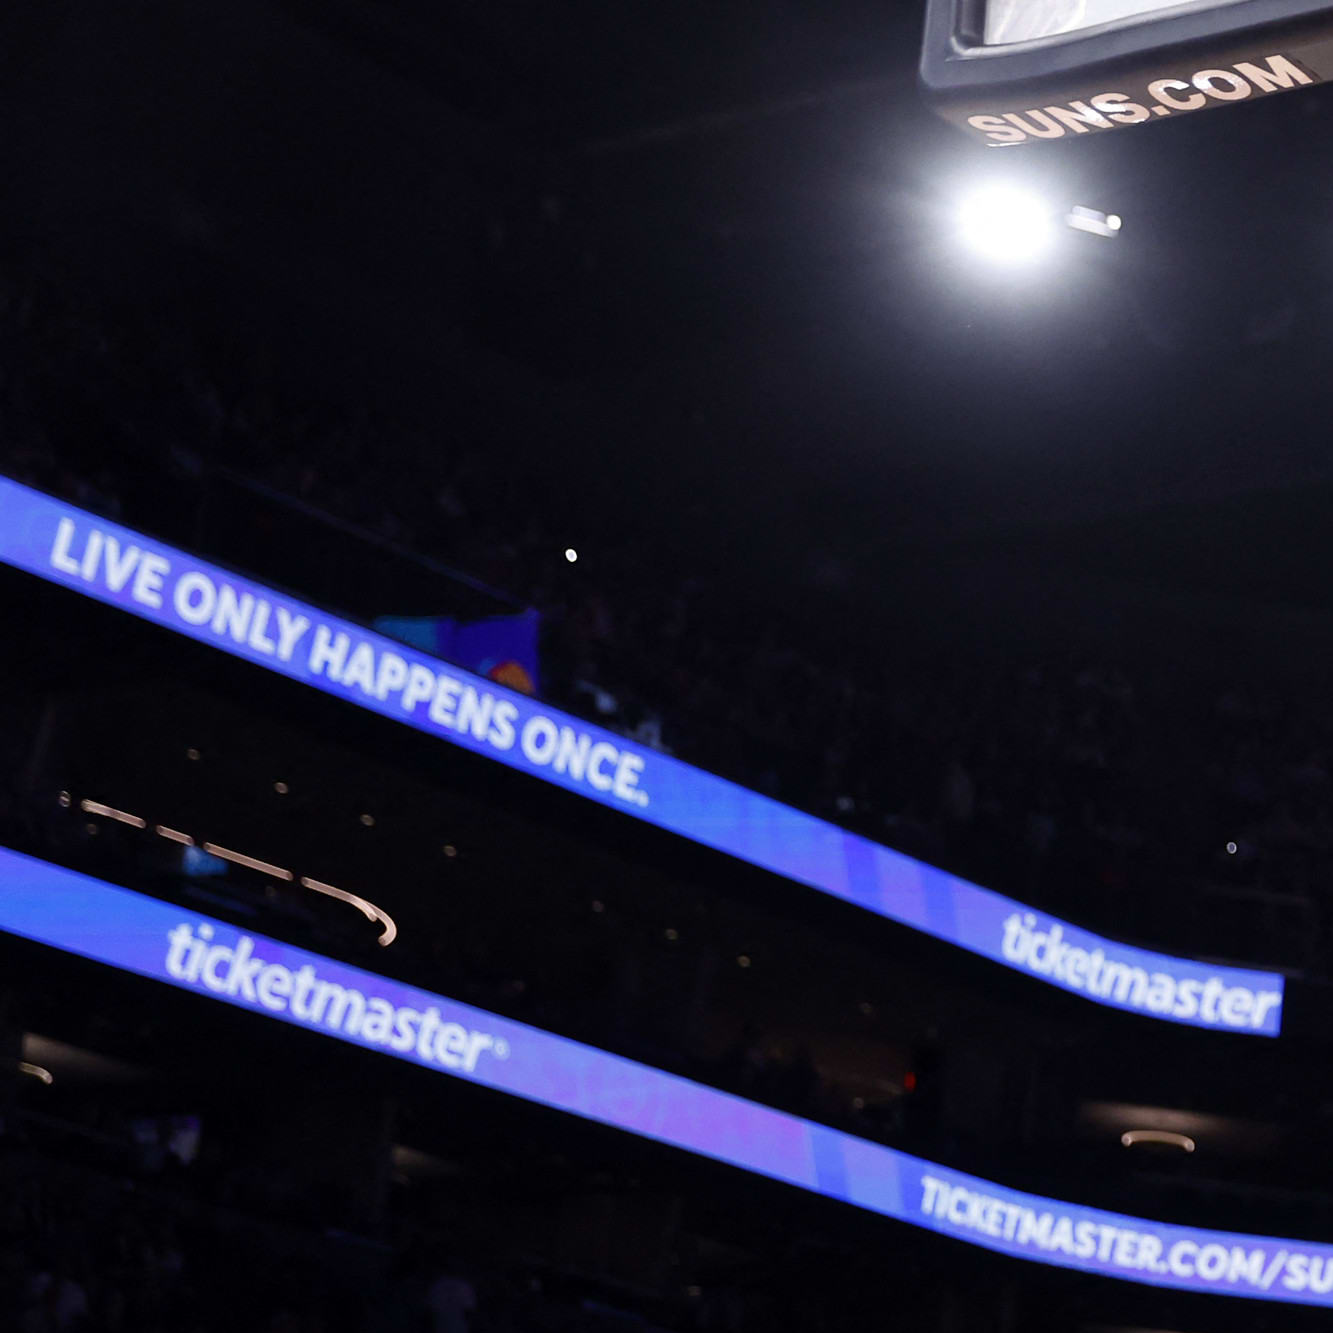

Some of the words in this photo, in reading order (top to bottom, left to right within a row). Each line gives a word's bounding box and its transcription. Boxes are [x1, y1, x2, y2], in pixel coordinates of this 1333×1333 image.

[968, 55, 1313, 143] SUNS.COM
[51, 516, 171, 610] LIVE
[173, 571, 311, 662] ONLY
[308, 625, 519, 750] HAPPENS
[521, 715, 649, 807] ONCE.
[1002, 912, 1282, 1028] ticketmaster
